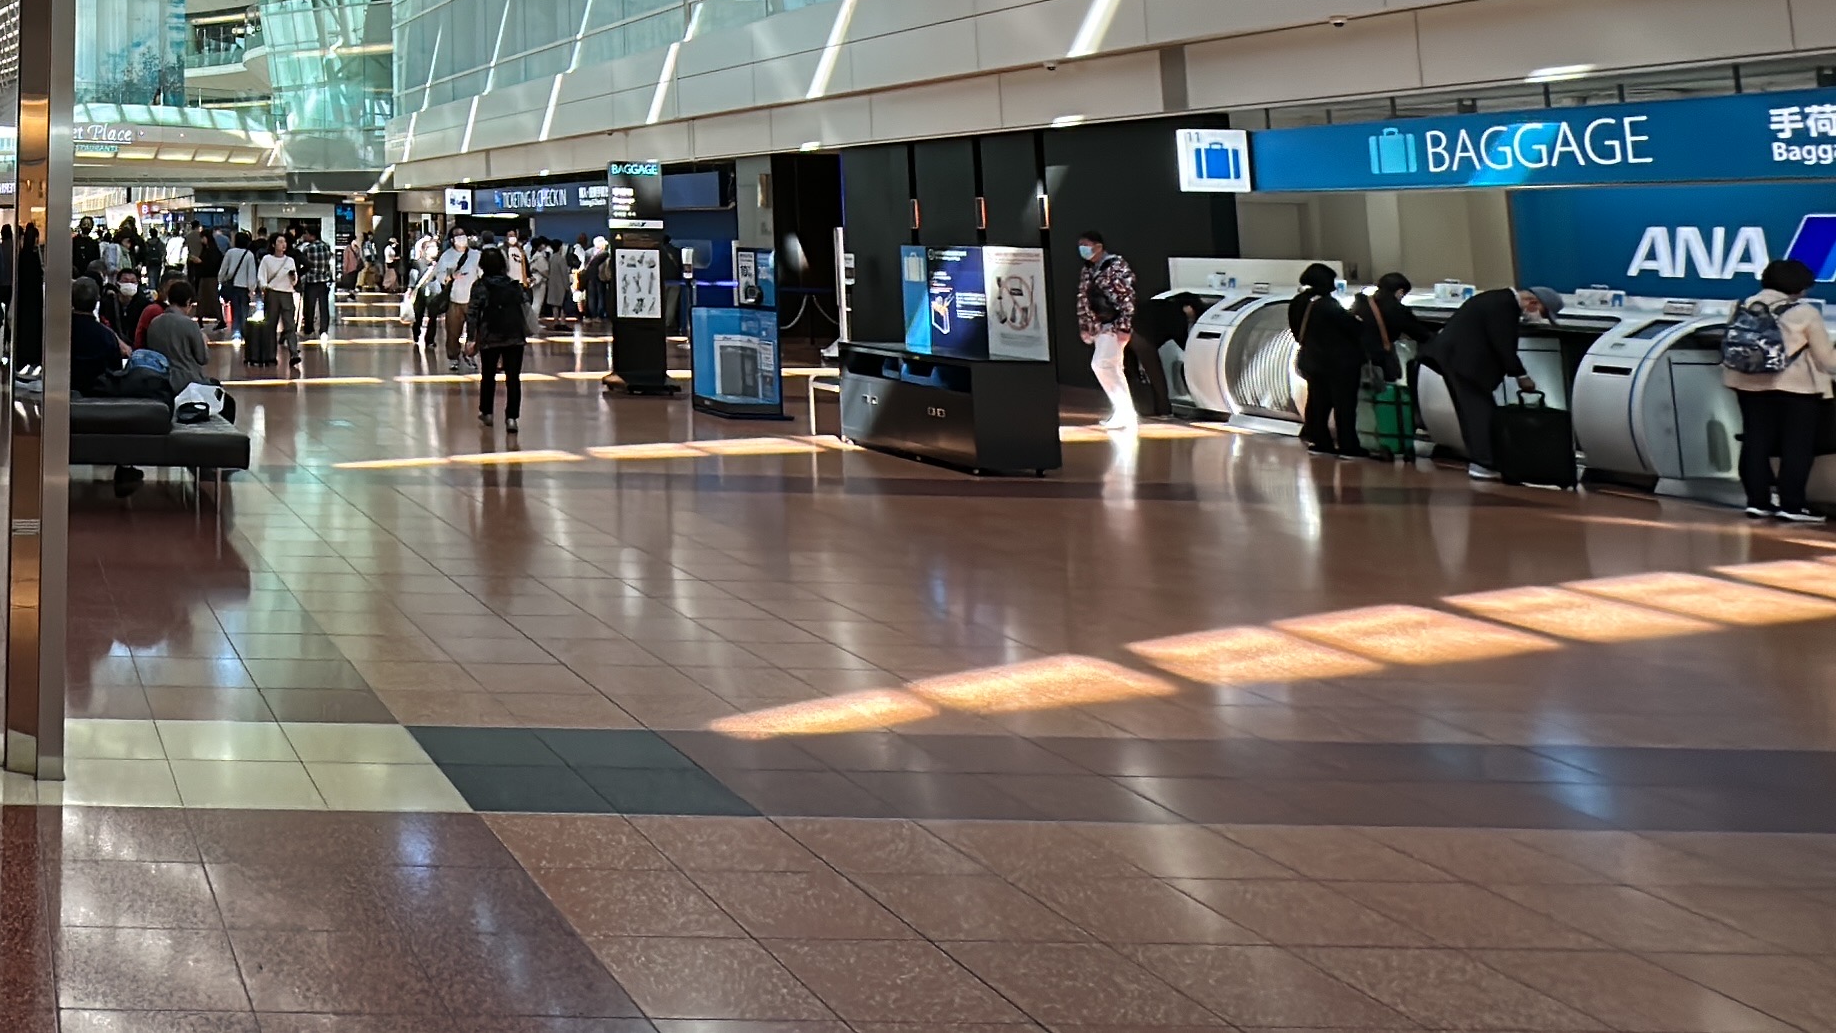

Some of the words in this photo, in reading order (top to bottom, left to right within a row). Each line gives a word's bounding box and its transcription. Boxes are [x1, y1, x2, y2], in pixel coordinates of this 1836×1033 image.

[87, 122, 132, 142] Place
[1187, 131, 1200, 143] 11
[1425, 116, 1654, 173] BAGGAGE
[1771, 141, 1836, 166] Bagg
[611, 163, 659, 175] BAGGAGE
[1627, 226, 1770, 280] ANA
